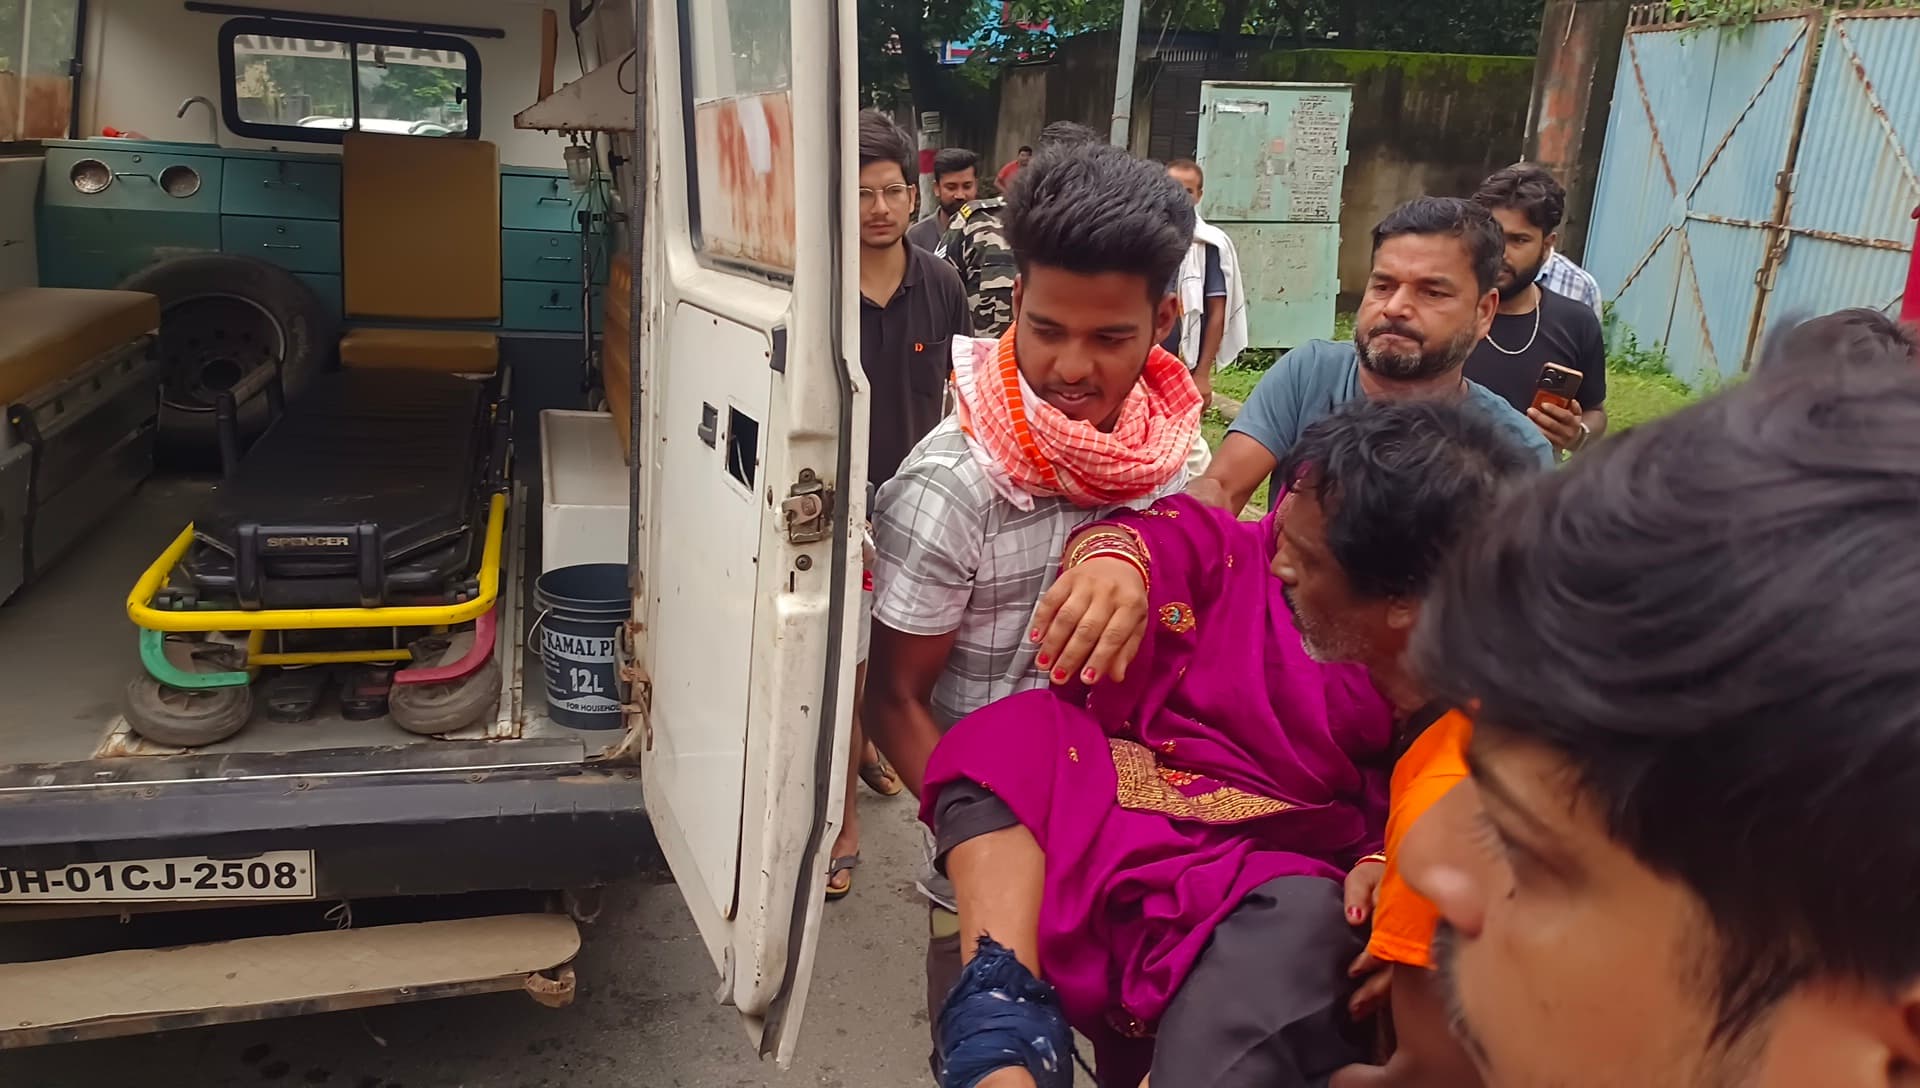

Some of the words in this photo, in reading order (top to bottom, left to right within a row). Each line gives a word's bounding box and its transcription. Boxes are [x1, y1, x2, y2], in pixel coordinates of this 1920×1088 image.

[266, 537, 349, 546] SPENCER
[547, 631, 596, 656] KAMAL
[569, 667, 604, 694] 12L
[566, 702, 579, 711] FOR
[0, 861, 297, 894] JH-01CJ-2508
